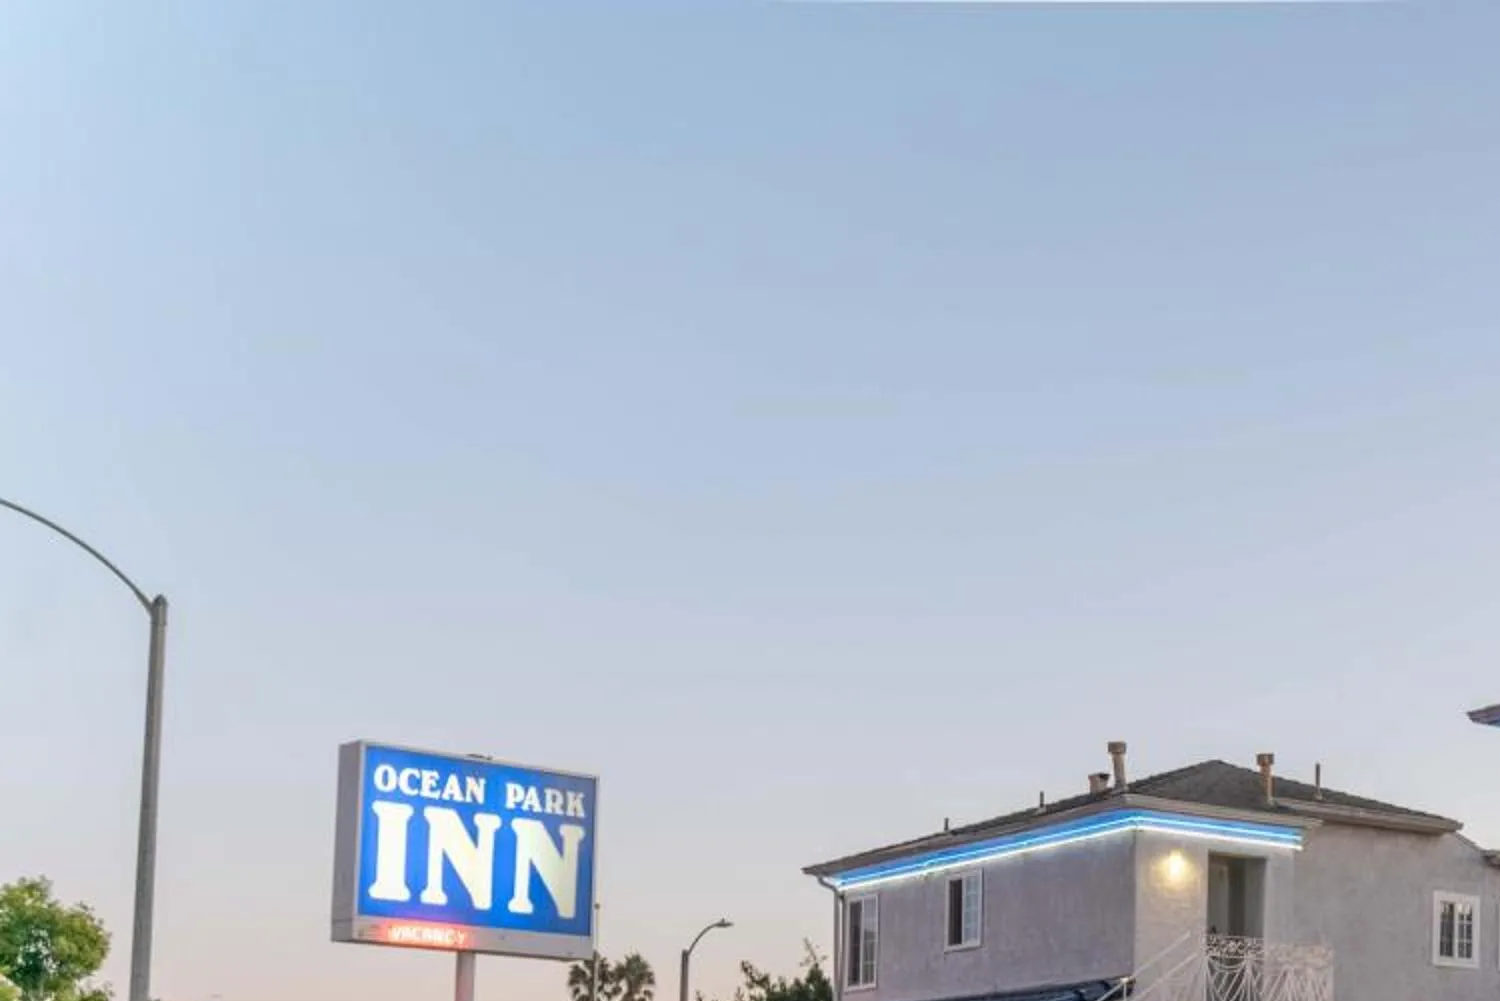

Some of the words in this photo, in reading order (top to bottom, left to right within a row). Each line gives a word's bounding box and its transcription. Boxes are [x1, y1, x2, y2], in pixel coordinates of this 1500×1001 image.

[373, 763, 487, 804] OCEAN
[505, 781, 587, 818] PARK
[368, 799, 586, 919] INN
[390, 925, 466, 945] VACANCY
